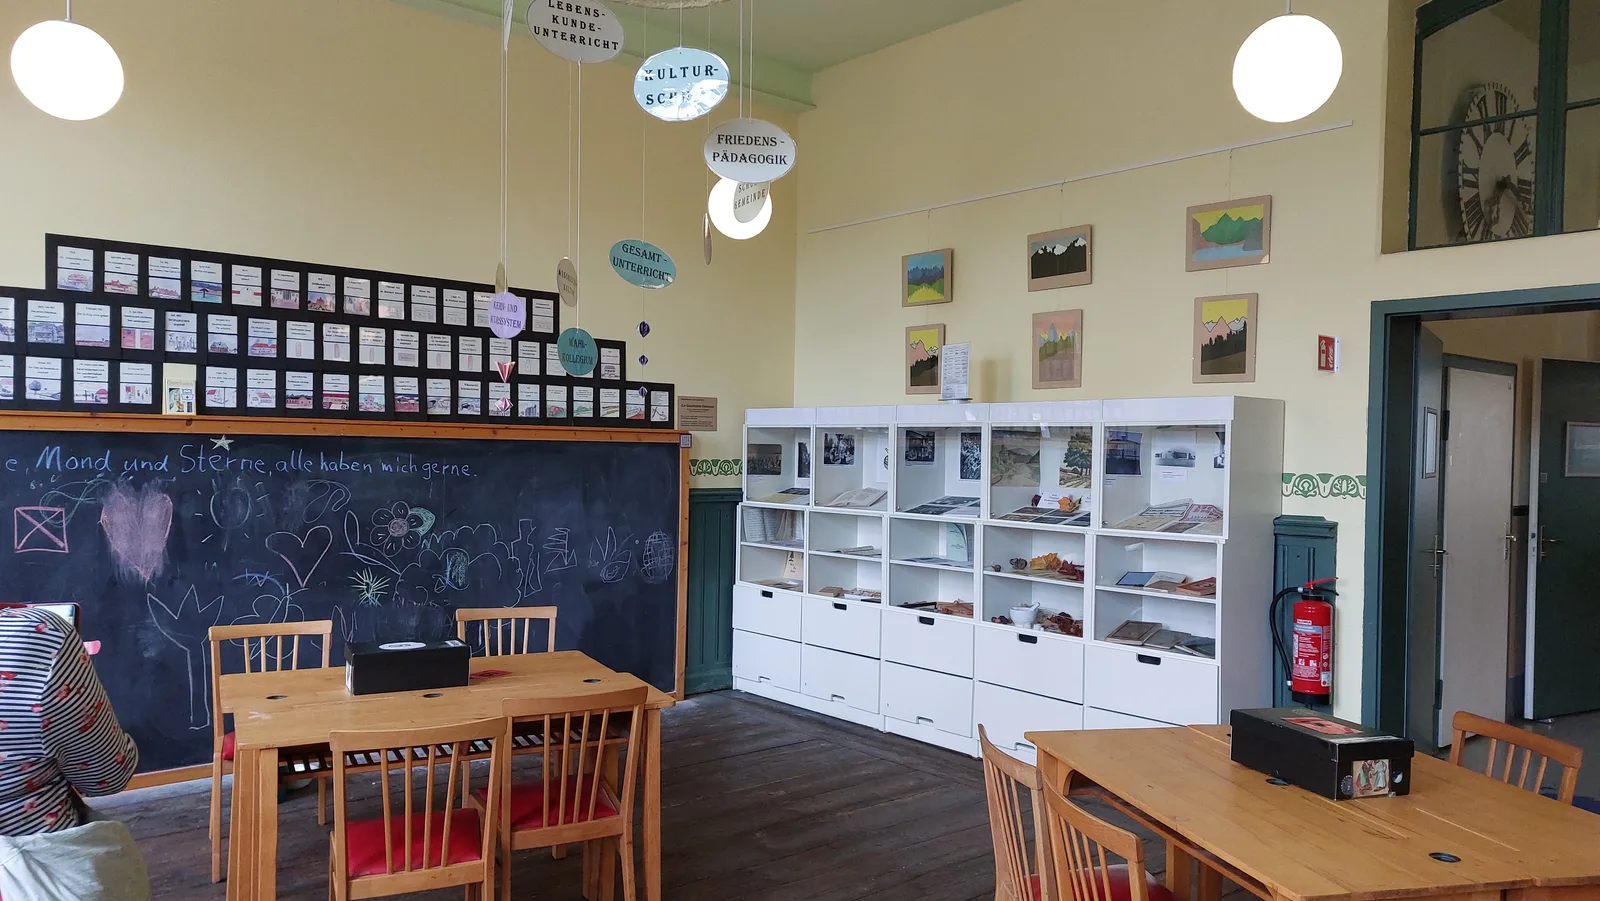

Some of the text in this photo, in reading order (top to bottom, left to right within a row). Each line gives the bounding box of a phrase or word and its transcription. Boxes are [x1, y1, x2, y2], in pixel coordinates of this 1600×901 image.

[548, 0, 606, 18] LEBENS-
[552, 15, 601, 32] KUNDE-
[533, 26, 619, 50] UNTERRICHT
[645, 65, 719, 81] KULTUR-
[712, 149, 788, 165] PÄDAGOGIK
[734, 189, 766, 210] GEMEINDE
[612, 256, 672, 282] UNTERRICHT
[36, 446, 111, 472] Mond
[124, 455, 168, 472] und
[179, 444, 272, 477] Sterne,
[275, 449, 313, 473] alle
[320, 451, 373, 473] haben
[381, 454, 418, 473] mich
[421, 461, 477, 480] gerne.
